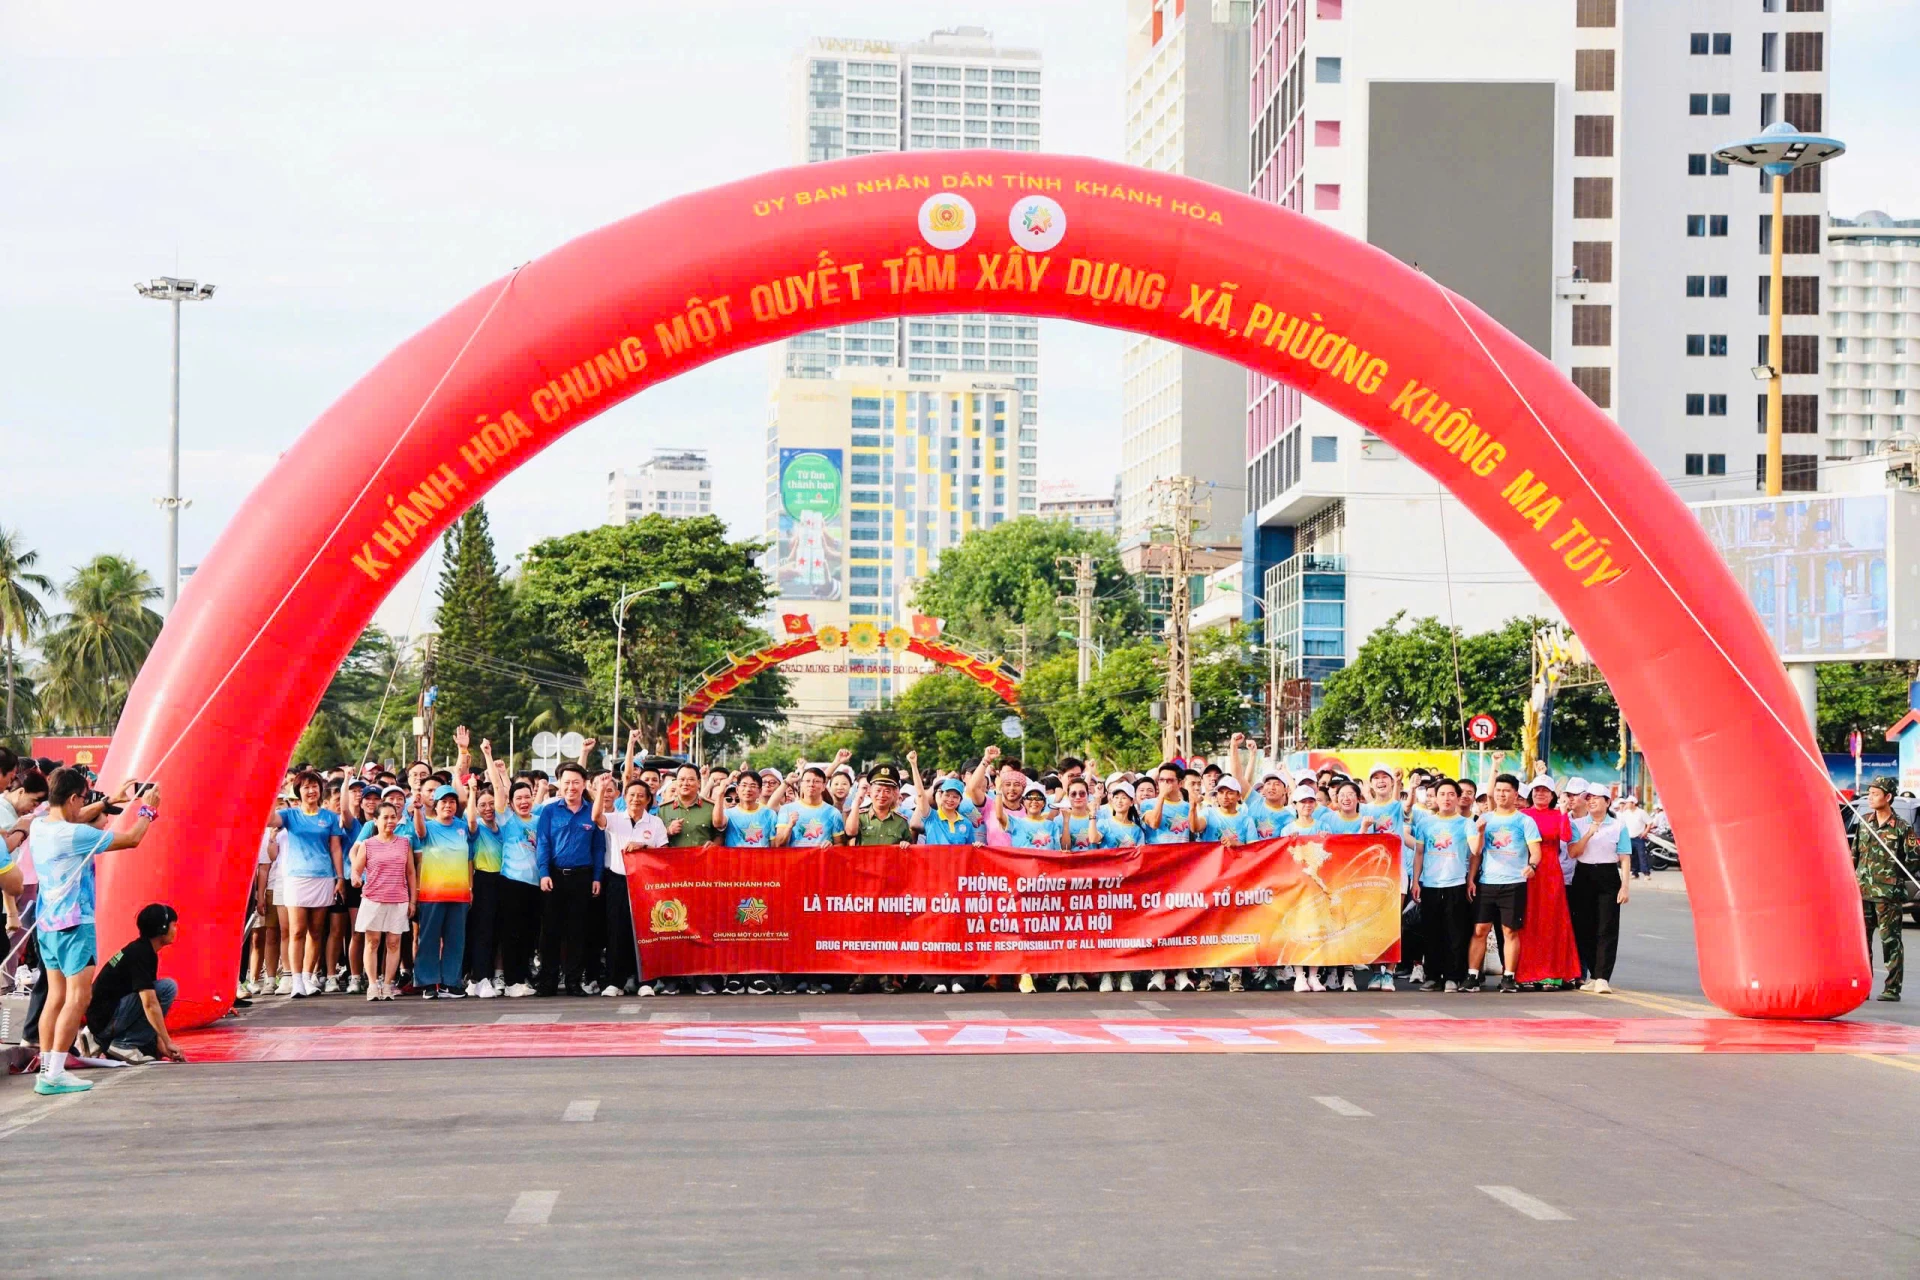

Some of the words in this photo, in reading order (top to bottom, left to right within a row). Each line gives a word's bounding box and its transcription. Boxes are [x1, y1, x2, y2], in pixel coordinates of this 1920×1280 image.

[795, 184, 848, 205] BAN
[857, 174, 930, 193] NHÂN
[941, 172, 993, 188] DÂN
[1075, 179, 1162, 208] KHÁNH
[1171, 199, 1223, 225] HÒA
[351, 462, 466, 582] KHÁNH
[460, 414, 533, 475] HÒA
[531, 336, 648, 424] CHUNG
[654, 296, 732, 359] MỘT
[750, 250, 864, 322] QUYẾT
[882, 247, 956, 295] TÂM
[975, 245, 1050, 292] XÂY
[1065, 258, 1166, 311] DỰNG
[1179, 281, 1238, 338] XÃ,
[1389, 379, 1506, 477] KHÔNG
[1501, 469, 1563, 531] MA
[1550, 517, 1622, 588] TÚY
[671, 880, 694, 888] NHÂN
[696, 880, 712, 888] DÂN
[734, 880, 762, 888] KHÁNH
[958, 872, 1012, 894] PHÒNG,
[1016, 872, 1066, 893] CHỐNG
[1070, 877, 1092, 891] MA
[803, 893, 821, 912] LÀ
[826, 893, 874, 913] TRÁCH
[878, 893, 926, 916] NHIỆM
[931, 892, 960, 913] CỦA
[964, 892, 993, 914] MỖI
[996, 893, 1017, 914] CÁ
[1021, 894, 1065, 913] NHÂN,
[1069, 895, 1093, 911] GIA
[1097, 890, 1136, 911] ĐÌNH,
[1141, 891, 1161, 909] CƠ
[1165, 892, 1209, 910] QUAN,
[1212, 886, 1231, 907] TỔ
[1235, 886, 1274, 906] CHỨC
[966, 915, 986, 934] VÀ
[989, 914, 1019, 934] CỦA
[1023, 914, 1060, 933] TOÀN
[1064, 913, 1084, 931] XÃ
[1087, 912, 1112, 933] HỘI
[815, 940, 840, 950] DRUG
[842, 940, 898, 951] PREVENTION
[901, 941, 919, 951] AND
[922, 941, 962, 952] CONTROL
[964, 941, 974, 952] IS
[976, 941, 992, 952] THE
[994, 939, 1064, 952] RESPONSIBILITY
[1067, 939, 1078, 949] OF
[1080, 939, 1095, 949] ALL
[1097, 937, 1154, 949] INDIVIDUALS,
[1157, 935, 1197, 947] FAMILIES
[1200, 935, 1218, 945] AND
[659, 1023, 1386, 1047] START
